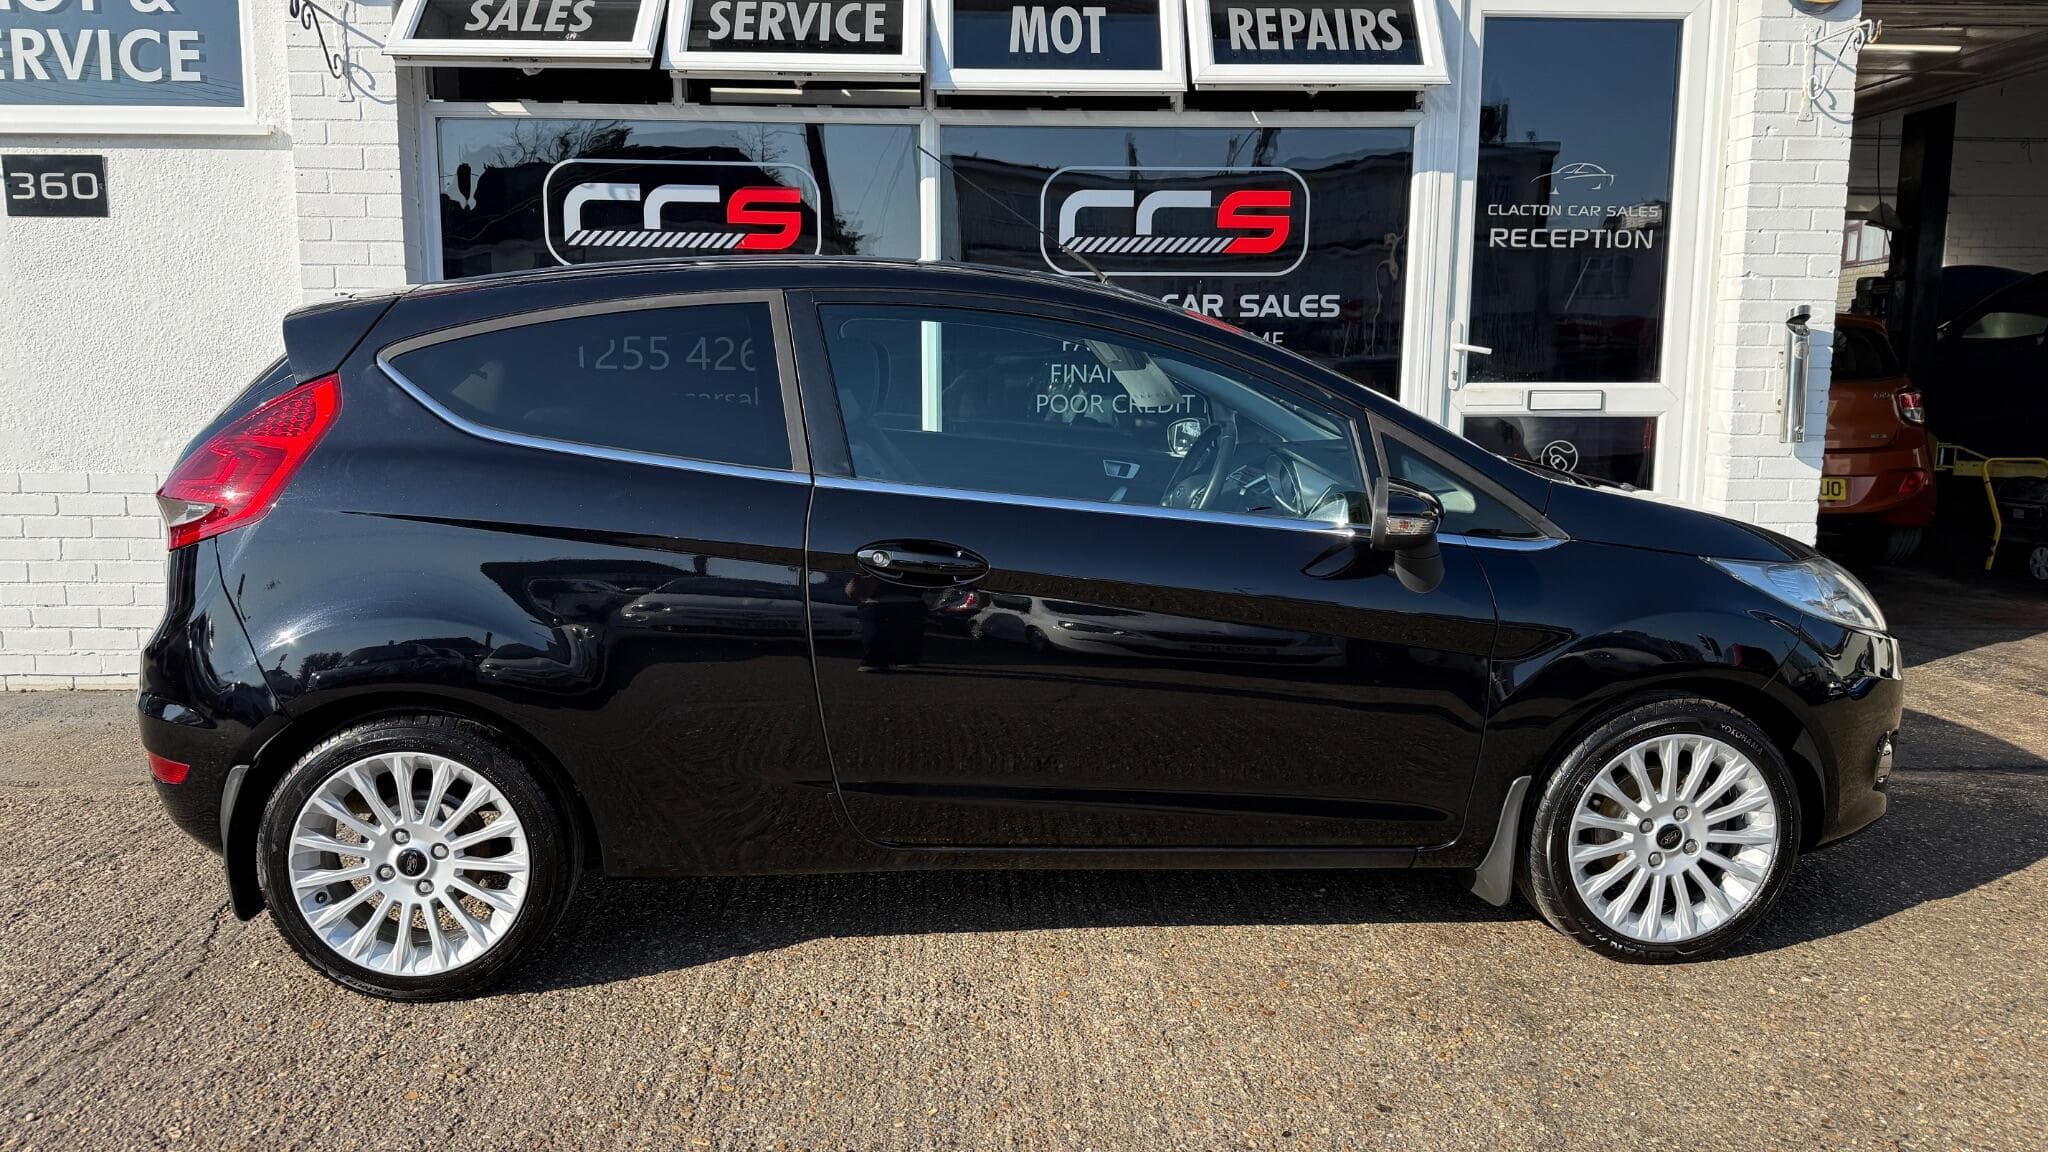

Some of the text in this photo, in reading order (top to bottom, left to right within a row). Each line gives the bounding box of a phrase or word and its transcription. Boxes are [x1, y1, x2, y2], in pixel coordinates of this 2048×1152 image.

[464, 0, 596, 32] SALES
[707, 0, 886, 42] SERVICE
[1228, 8, 1403, 51] REPAIRS
[1009, 6, 1106, 54] MOT
[0, 29, 201, 82] RVICE
[10, 173, 99, 200] 360
[1487, 204, 1659, 218] CLACTON CAR SALES
[1489, 228, 1654, 249] RECEPTION
[1239, 294, 1341, 318] SALES
[1051, 364, 1112, 384] FINA
[1036, 394, 1104, 413] POOR
